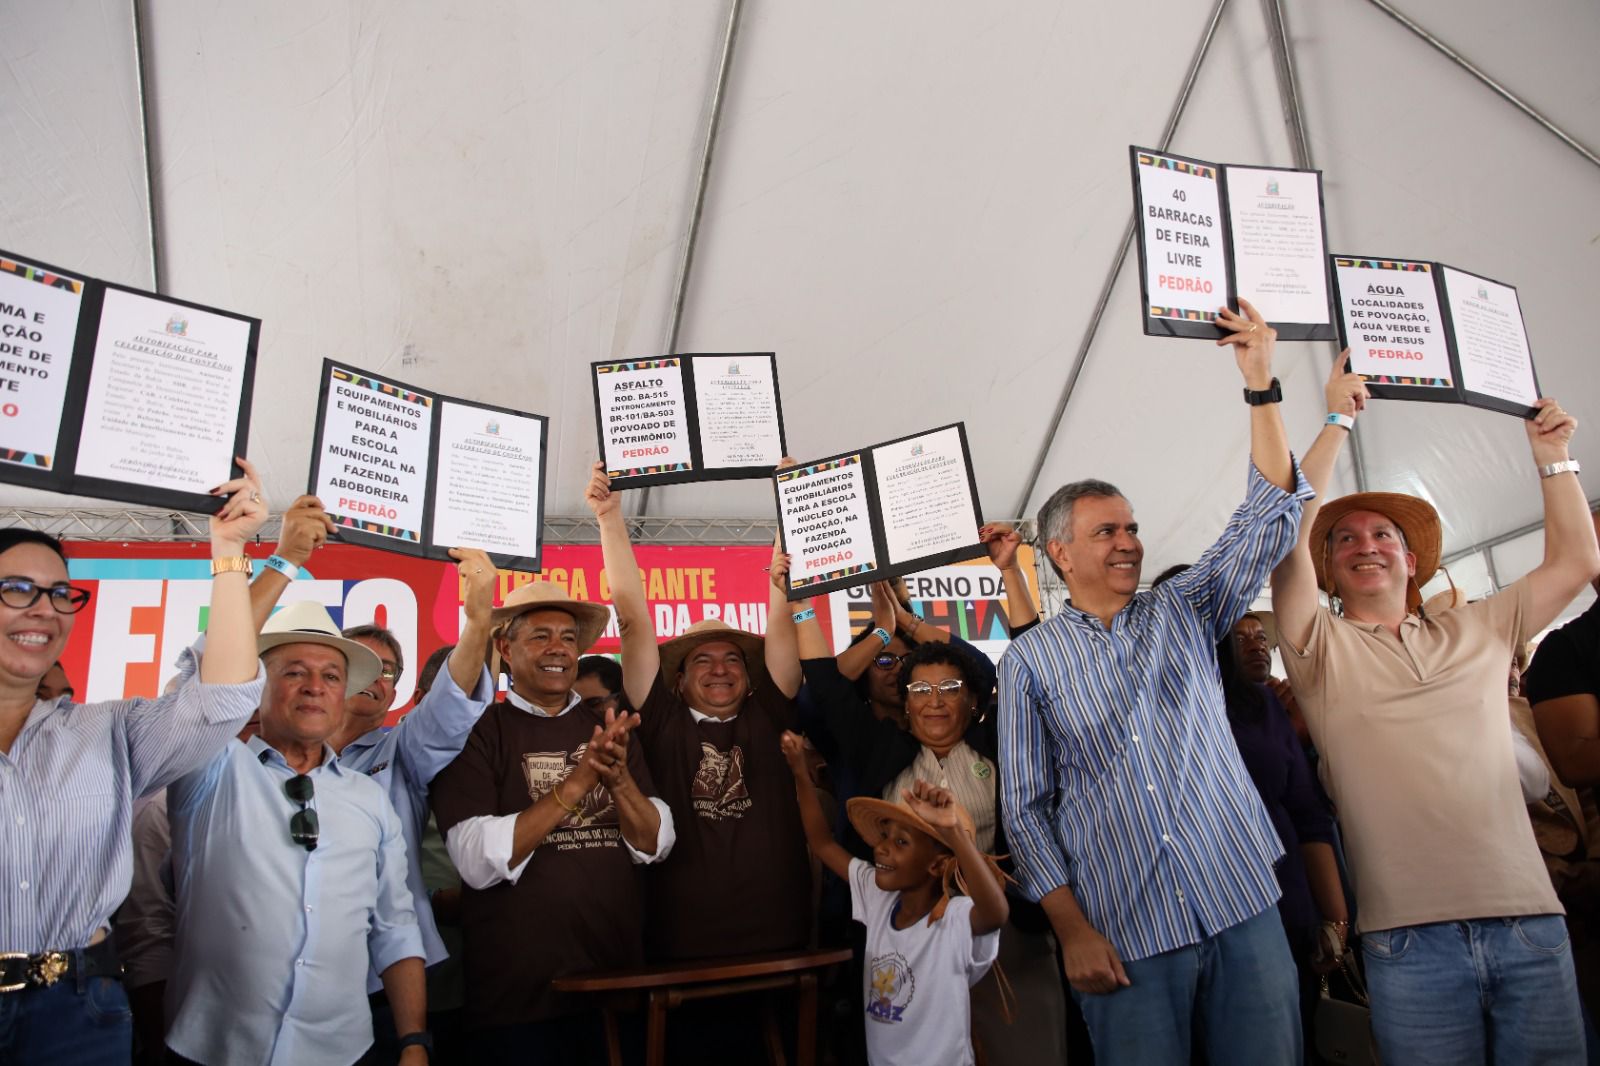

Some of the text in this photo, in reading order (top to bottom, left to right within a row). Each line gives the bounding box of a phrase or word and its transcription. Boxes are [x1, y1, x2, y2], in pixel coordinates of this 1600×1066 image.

[1172, 189, 1186, 202] 40
[1149, 205, 1213, 228] BARRACAS
[1156, 228, 1210, 248] DE FEIRA
[1167, 252, 1202, 268] LIVRE
[1158, 274, 1213, 294] PEDRÃO
[1367, 283, 1405, 295] ÁGUA
[1351, 299, 1424, 310] LOCALIDADES
[33, 312, 45, 324] E
[1350, 310, 1430, 323] DE POVOAÇÃO,
[1353, 322, 1431, 334] ÁGUA VERDE E
[1363, 334, 1425, 345] BOM JESUS
[29, 350, 52, 364] DE
[1368, 348, 1424, 361] PEDRÃO
[614, 379, 664, 391] ASFALTO
[336, 386, 421, 418] EQUIPAMENTOS
[615, 391, 668, 402] ROD. BA-515
[611, 400, 676, 412] ENTRONCAMENTO
[337, 401, 418, 431] E MOBILIÁRIOS
[355, 420, 398, 440] PARA A
[610, 420, 676, 435] (POVOADO DE
[351, 435, 399, 455] ESCOLA
[612, 432, 676, 445] PATRIMÔNIO)
[329, 445, 416, 475] MUNICIPAL NA
[622, 445, 669, 458] PEDRÃO
[344, 465, 400, 486] FAZENDA
[784, 471, 854, 494] EQUIPAMENTOS
[330, 477, 409, 503] ABOBOREIRA
[787, 482, 853, 504] E MOBILIÁRIOS
[339, 497, 397, 520] PEDRÃO
[787, 492, 857, 515] PARA A ESCOLA
[797, 505, 849, 523] NÚCLEO DA
[791, 514, 858, 536] POVOAÇÃO, NA
[805, 528, 847, 543] FAZENDA
[802, 537, 852, 555] POVOAÇÃO
[805, 550, 854, 569] PEDRÃO
[655, 604, 692, 637] DA
[703, 603, 768, 634] BAHI
